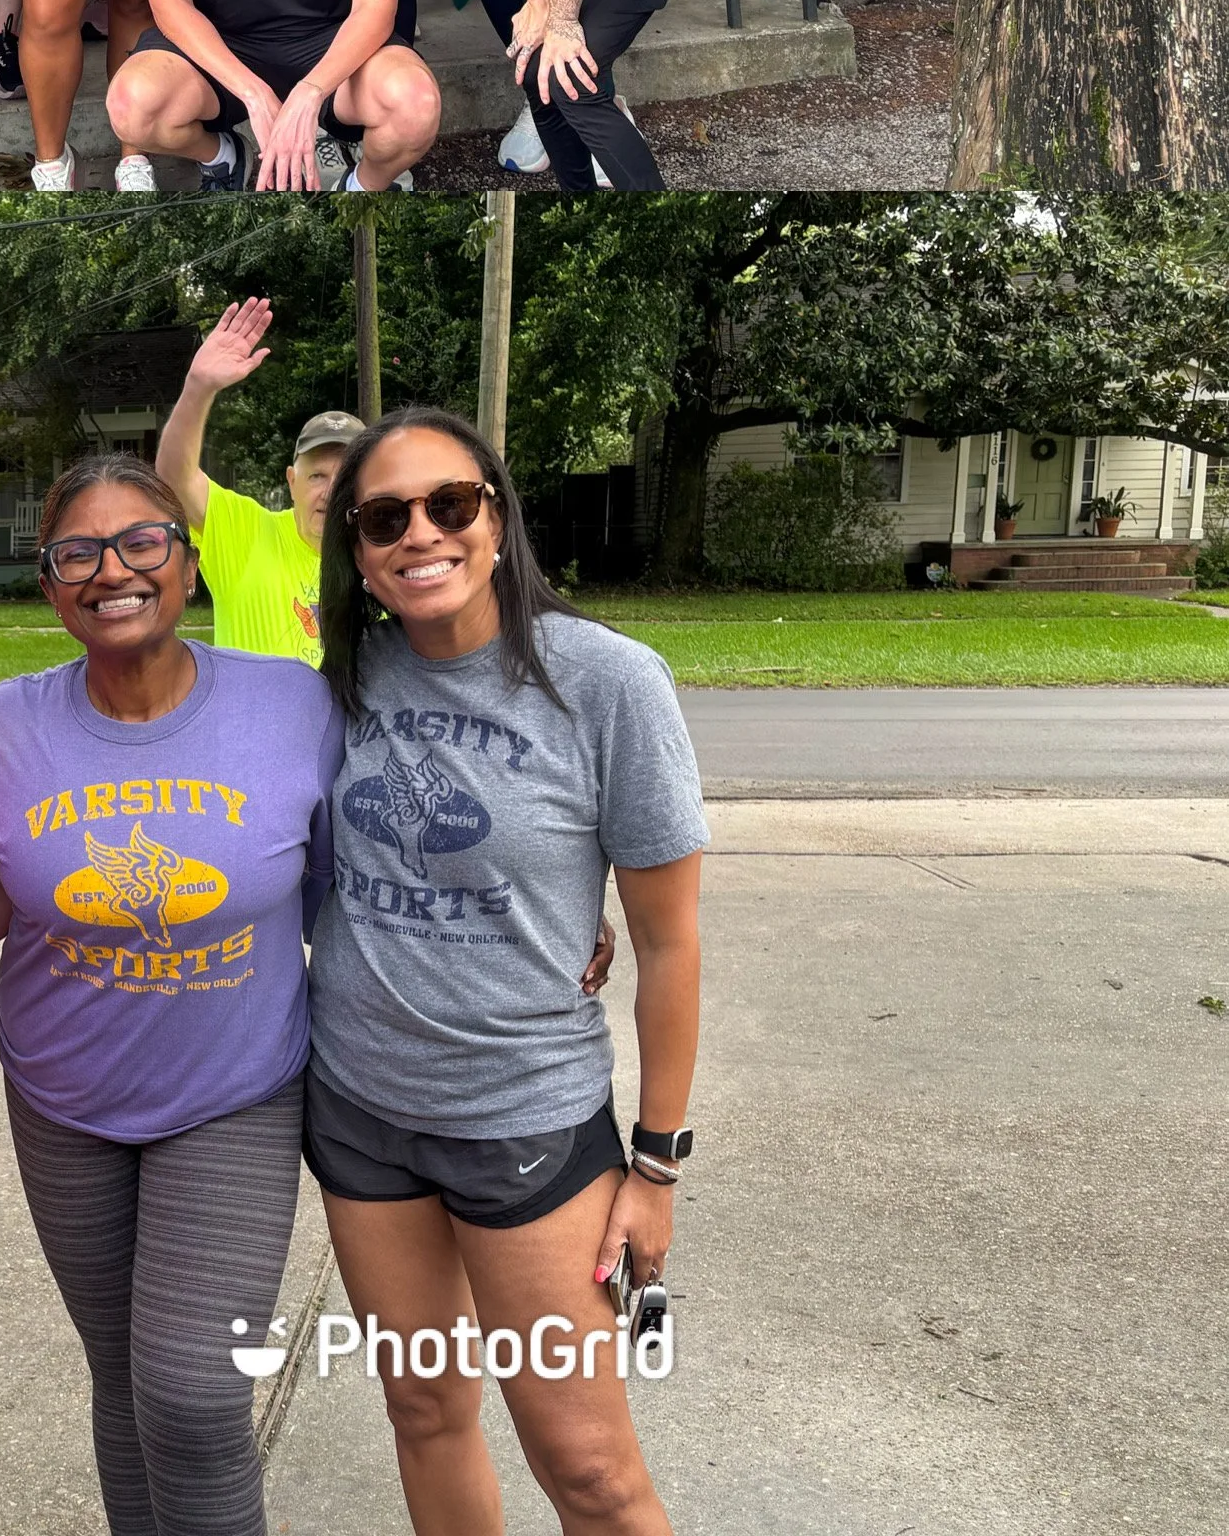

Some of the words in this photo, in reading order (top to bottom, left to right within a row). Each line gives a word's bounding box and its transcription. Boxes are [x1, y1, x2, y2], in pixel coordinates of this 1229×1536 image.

[990, 431, 999, 466] 116
[24, 778, 249, 841] VARSITY
[435, 812, 479, 829] 2000
[174, 879, 218, 896] 2000
[345, 912, 366, 926] UGE
[373, 918, 431, 939] MANDEVILLE
[439, 932, 465, 943] NEW
[468, 933, 520, 946] ORLEANS
[44, 922, 256, 982] SPORTS
[113, 980, 178, 997] MANDEVILLE
[185, 980, 212, 992] NEW
[213, 967, 255, 989] ORLEANS
